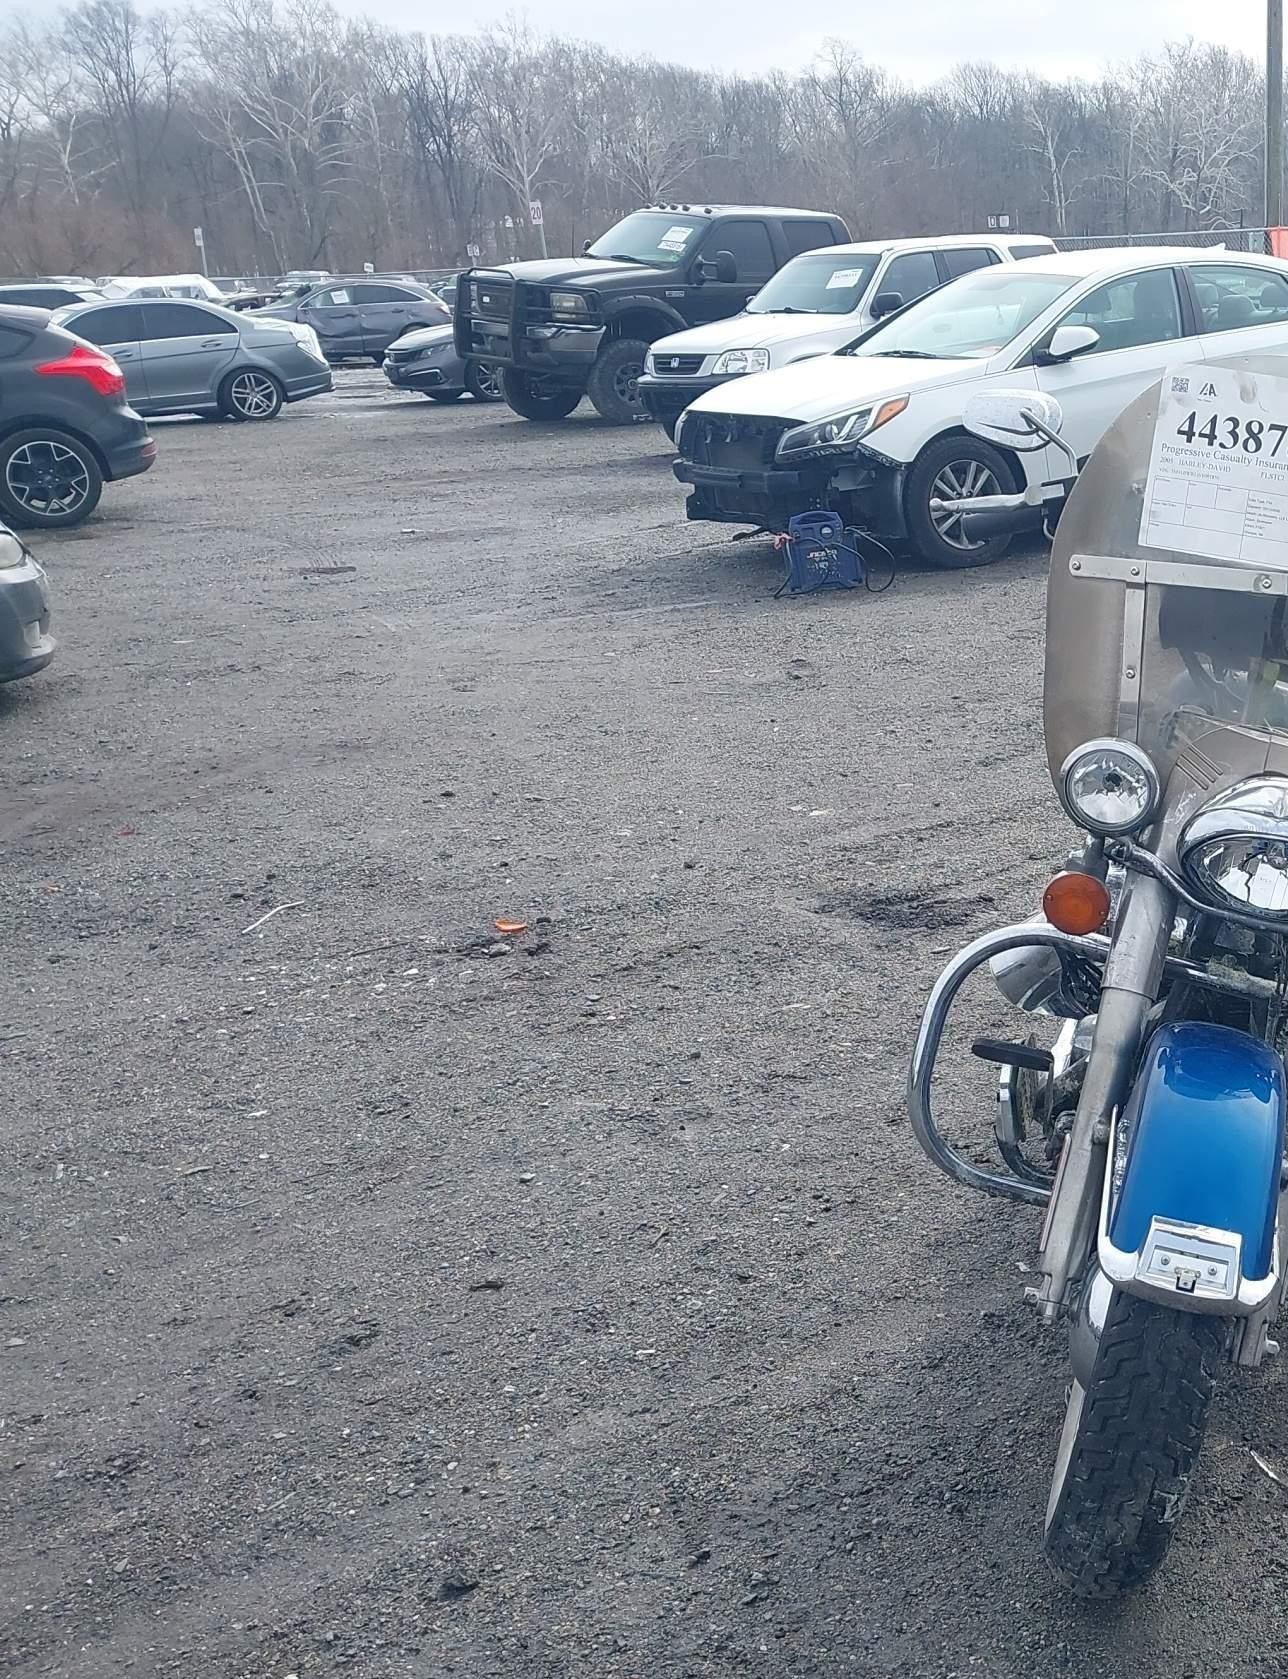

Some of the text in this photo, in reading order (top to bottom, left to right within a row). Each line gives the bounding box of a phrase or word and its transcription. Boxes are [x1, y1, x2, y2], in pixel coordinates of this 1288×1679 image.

[530, 206, 542, 220] 20
[1161, 442, 1211, 458] Progressive
[1213, 450, 1253, 466] Casualty
